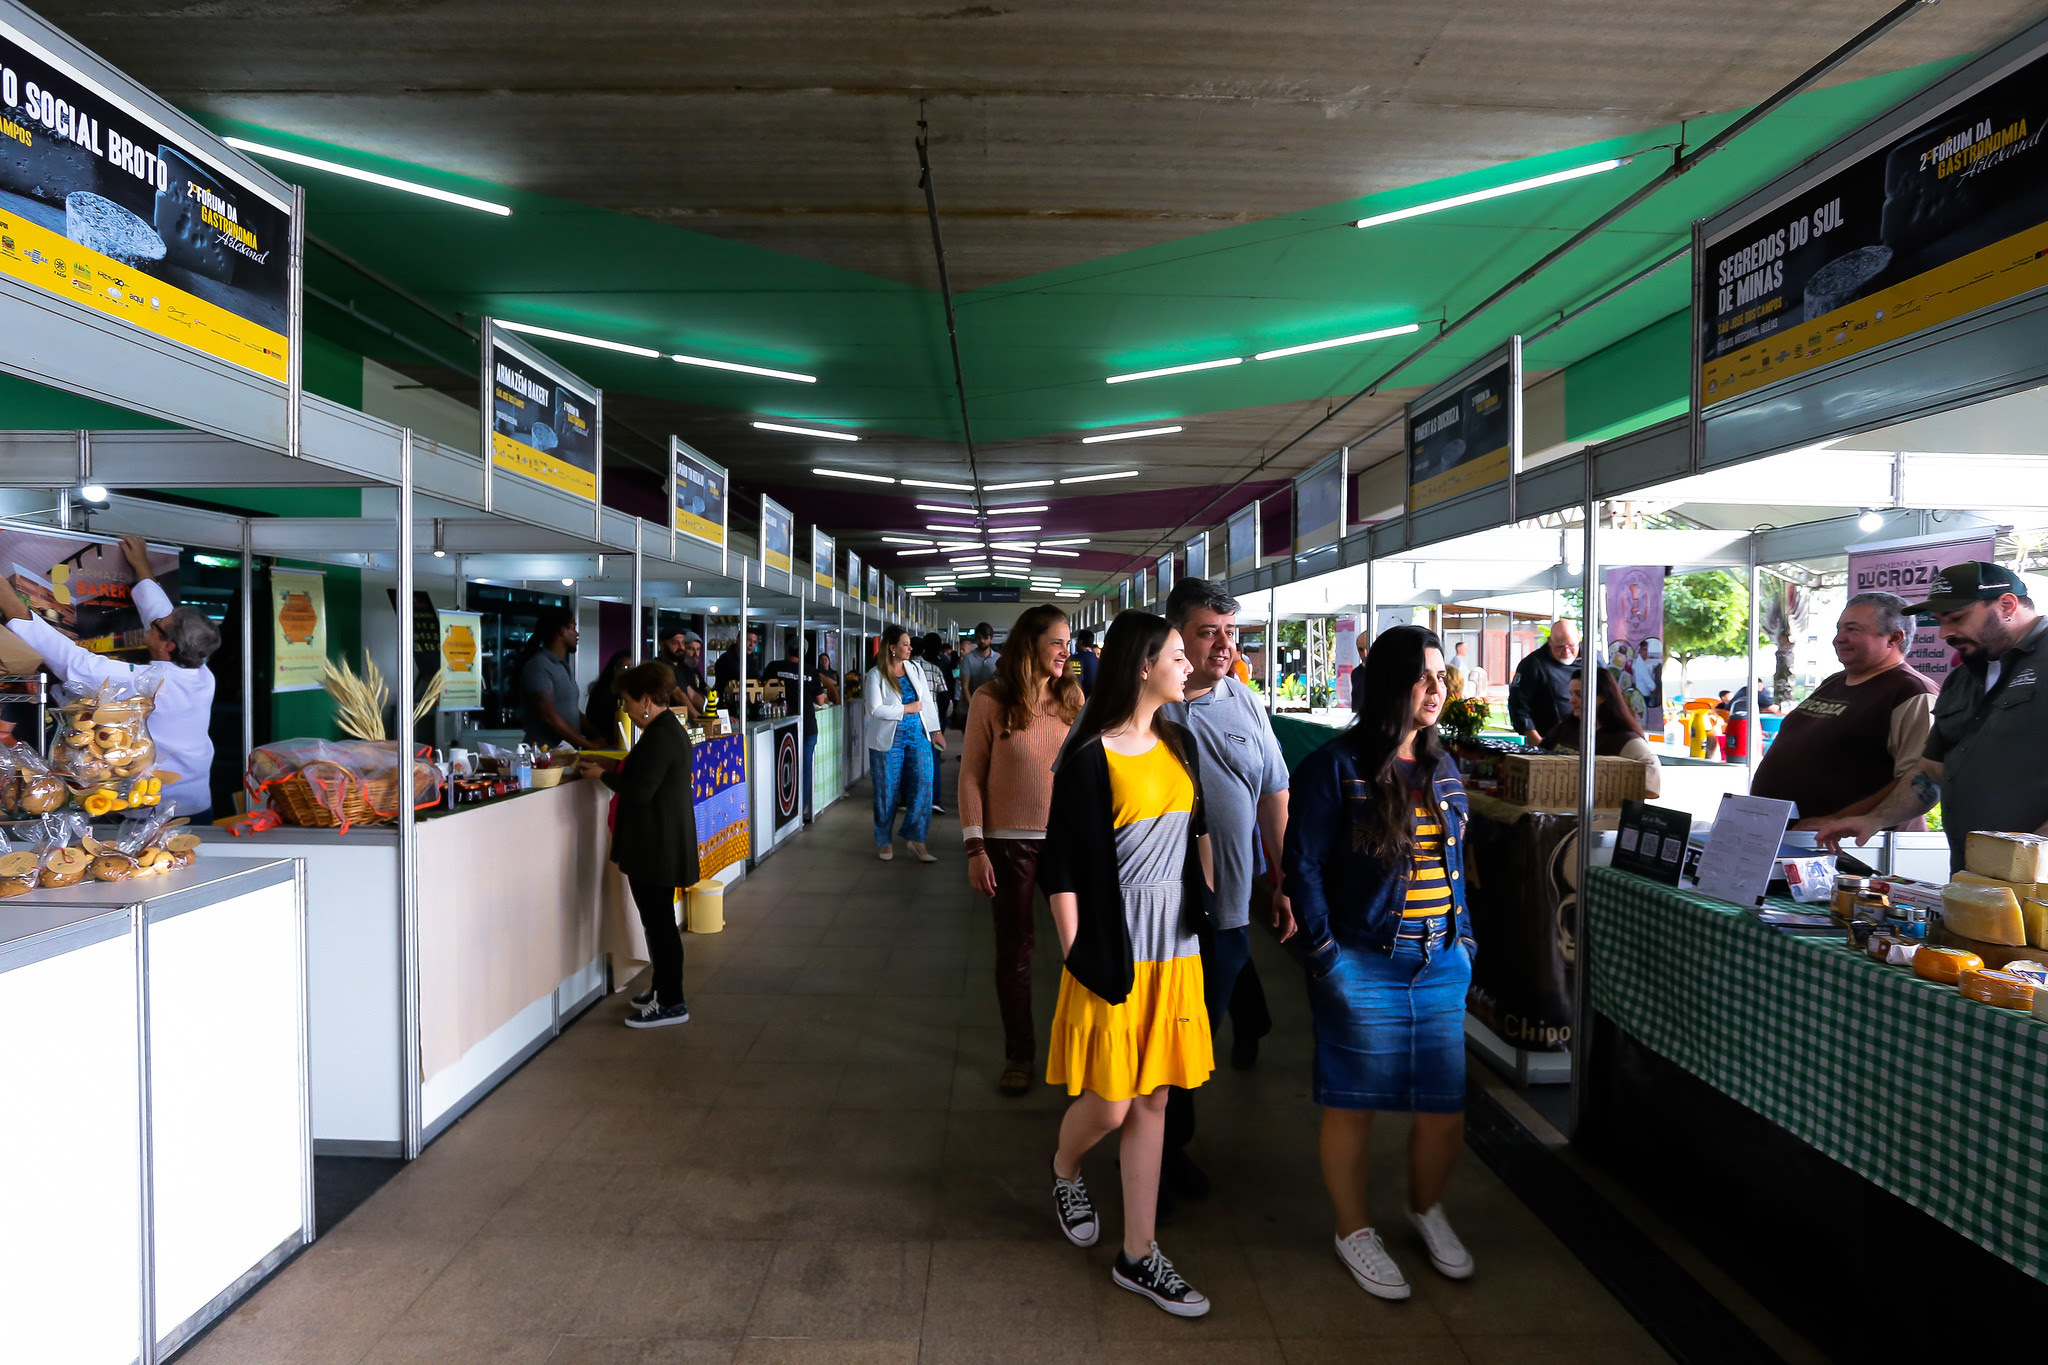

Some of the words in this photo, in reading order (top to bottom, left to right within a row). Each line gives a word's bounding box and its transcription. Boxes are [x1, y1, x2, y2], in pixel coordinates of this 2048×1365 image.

[0, 63, 18, 108] O
[26, 82, 103, 157] SOCIAL
[108, 128, 168, 192] BROTO
[1932, 128, 1972, 166] FÓRUM
[1976, 118, 1992, 138] DA
[1938, 118, 2028, 180] GASTRONOMIA
[197, 185, 226, 217] FÓRUM
[227, 203, 238, 224] DA
[201, 205, 258, 251] GASTRONOMIA
[215, 228, 270, 265] Artesanal
[1719, 227, 1785, 287] SEGREDOS
[1789, 216, 1808, 251] DO
[1813, 197, 1844, 238] SUL
[1718, 285, 1734, 316] DE
[1736, 260, 1783, 312] MINAS
[1757, 296, 1783, 319] CAMPOS
[496, 362, 527, 396] ARMAZÉM
[527, 381, 549, 408] BAKERY
[1857, 565, 1940, 587] DUCROZA
[1875, 559, 1922, 570] PIMENTAS
